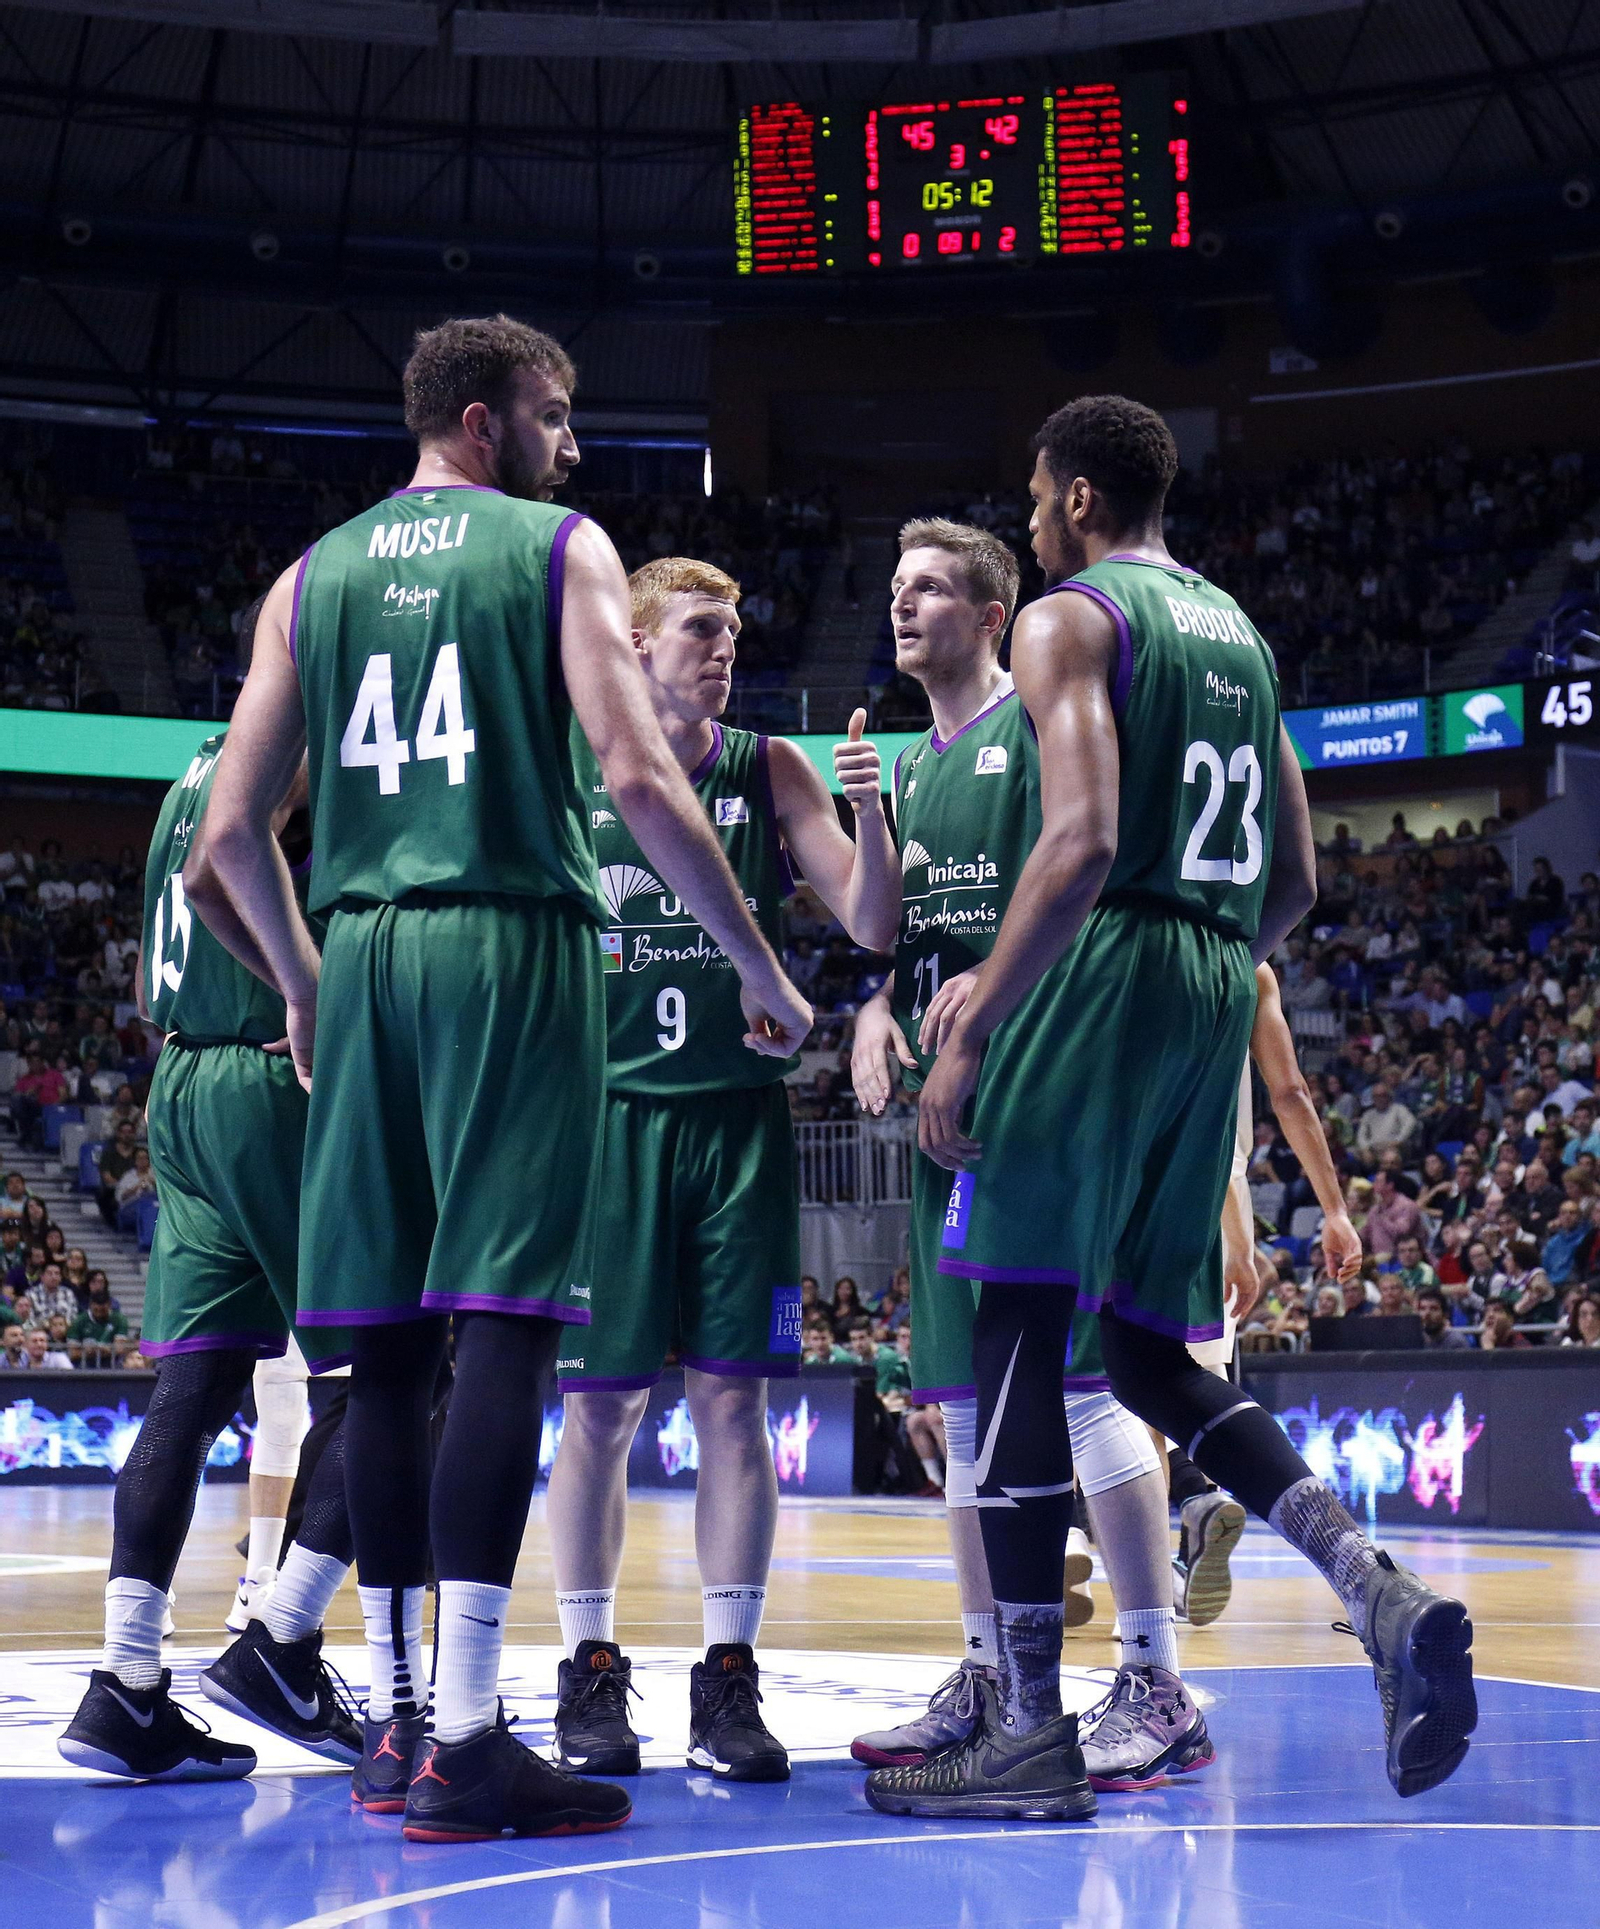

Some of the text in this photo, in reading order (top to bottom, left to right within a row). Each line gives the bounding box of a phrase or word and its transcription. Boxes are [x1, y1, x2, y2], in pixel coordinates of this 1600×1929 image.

[902, 121, 935, 150] 45
[985, 115, 1019, 145] 42
[949, 144, 966, 169] 3
[903, 233, 920, 257] 0
[998, 226, 1016, 251] 2
[367, 513, 470, 559] MUSLI
[1164, 595, 1255, 647] BROOKS
[340, 642, 475, 795] 44
[1320, 701, 1419, 729] JAMAR SMITH
[1541, 681, 1592, 728] 45
[1322, 730, 1409, 760] PUNTOS 7
[1180, 741, 1263, 886] 23
[927, 853, 998, 885] Unicaja
[152, 873, 191, 1002] 15
[950, 925, 997, 935] COSTA DEL SOL
[628, 932, 728, 973] Benaha
[911, 953, 939, 1020] 21
[656, 987, 687, 1051] 9
